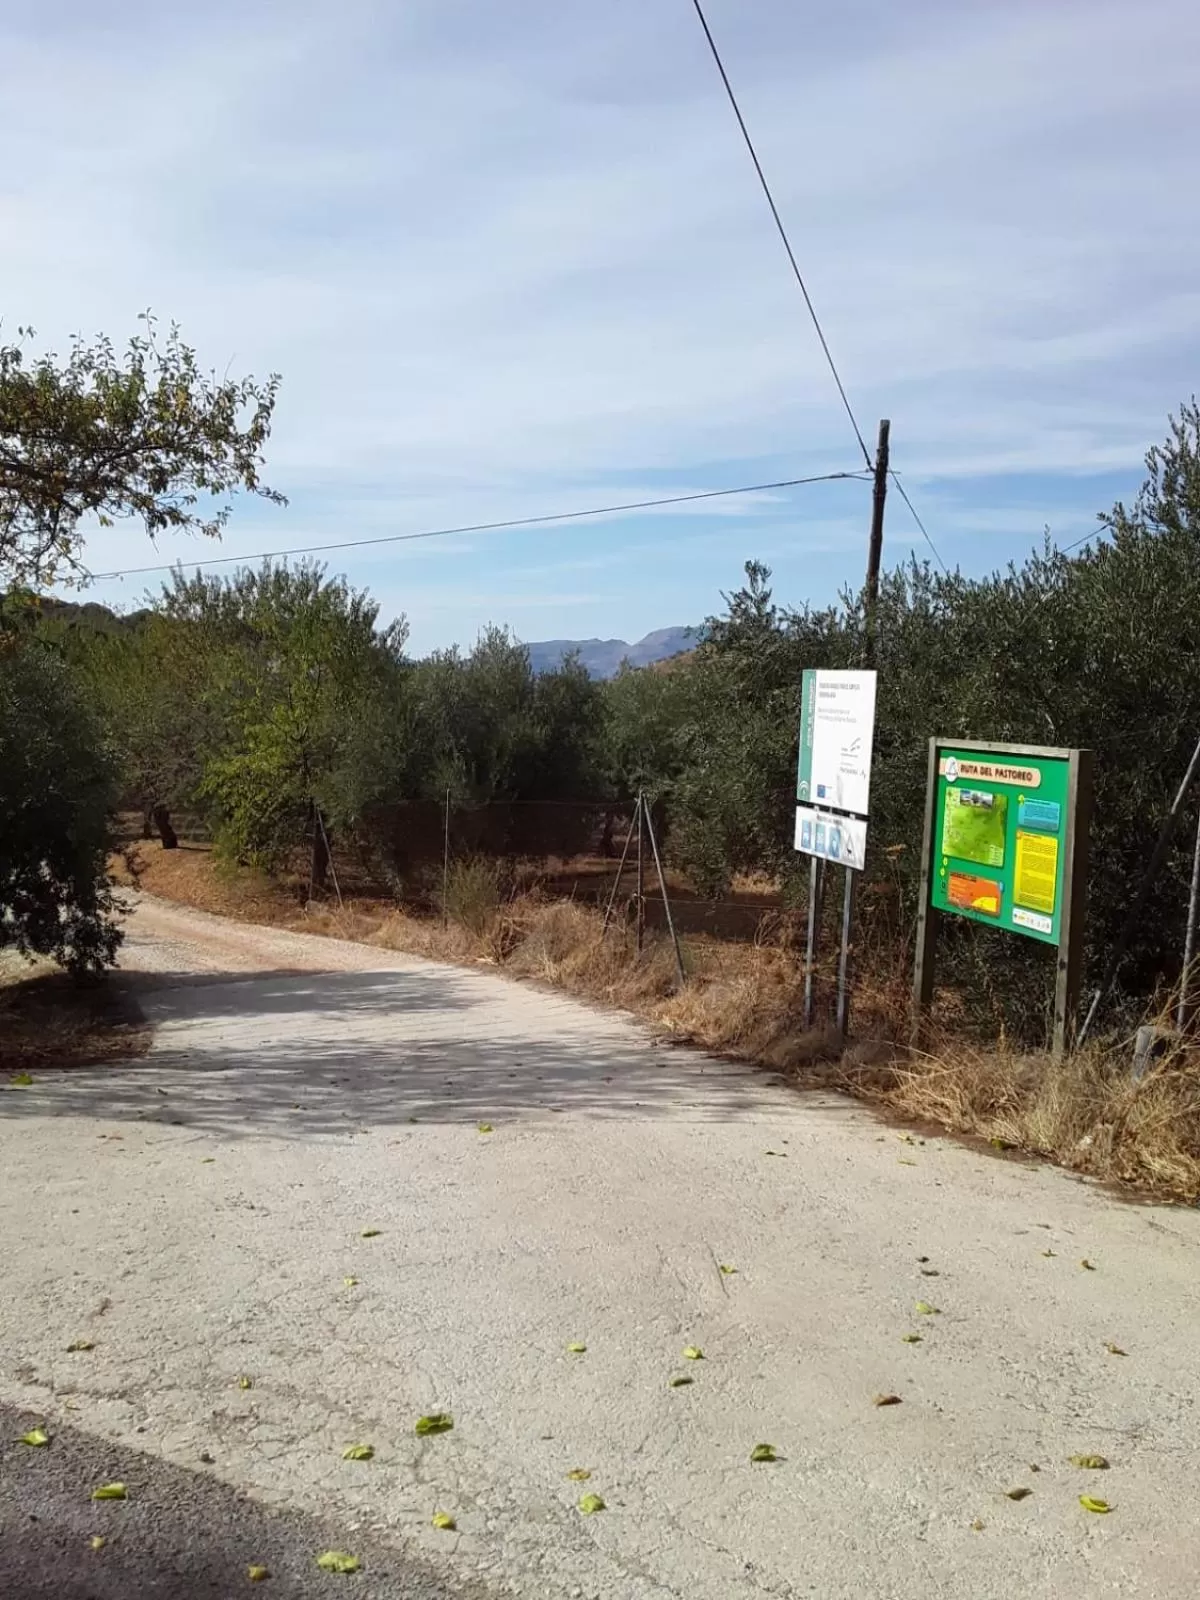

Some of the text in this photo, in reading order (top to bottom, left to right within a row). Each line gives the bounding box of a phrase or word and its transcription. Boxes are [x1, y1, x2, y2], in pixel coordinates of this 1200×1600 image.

[960, 764, 1032, 781] RUTA DEL PASTOREO
